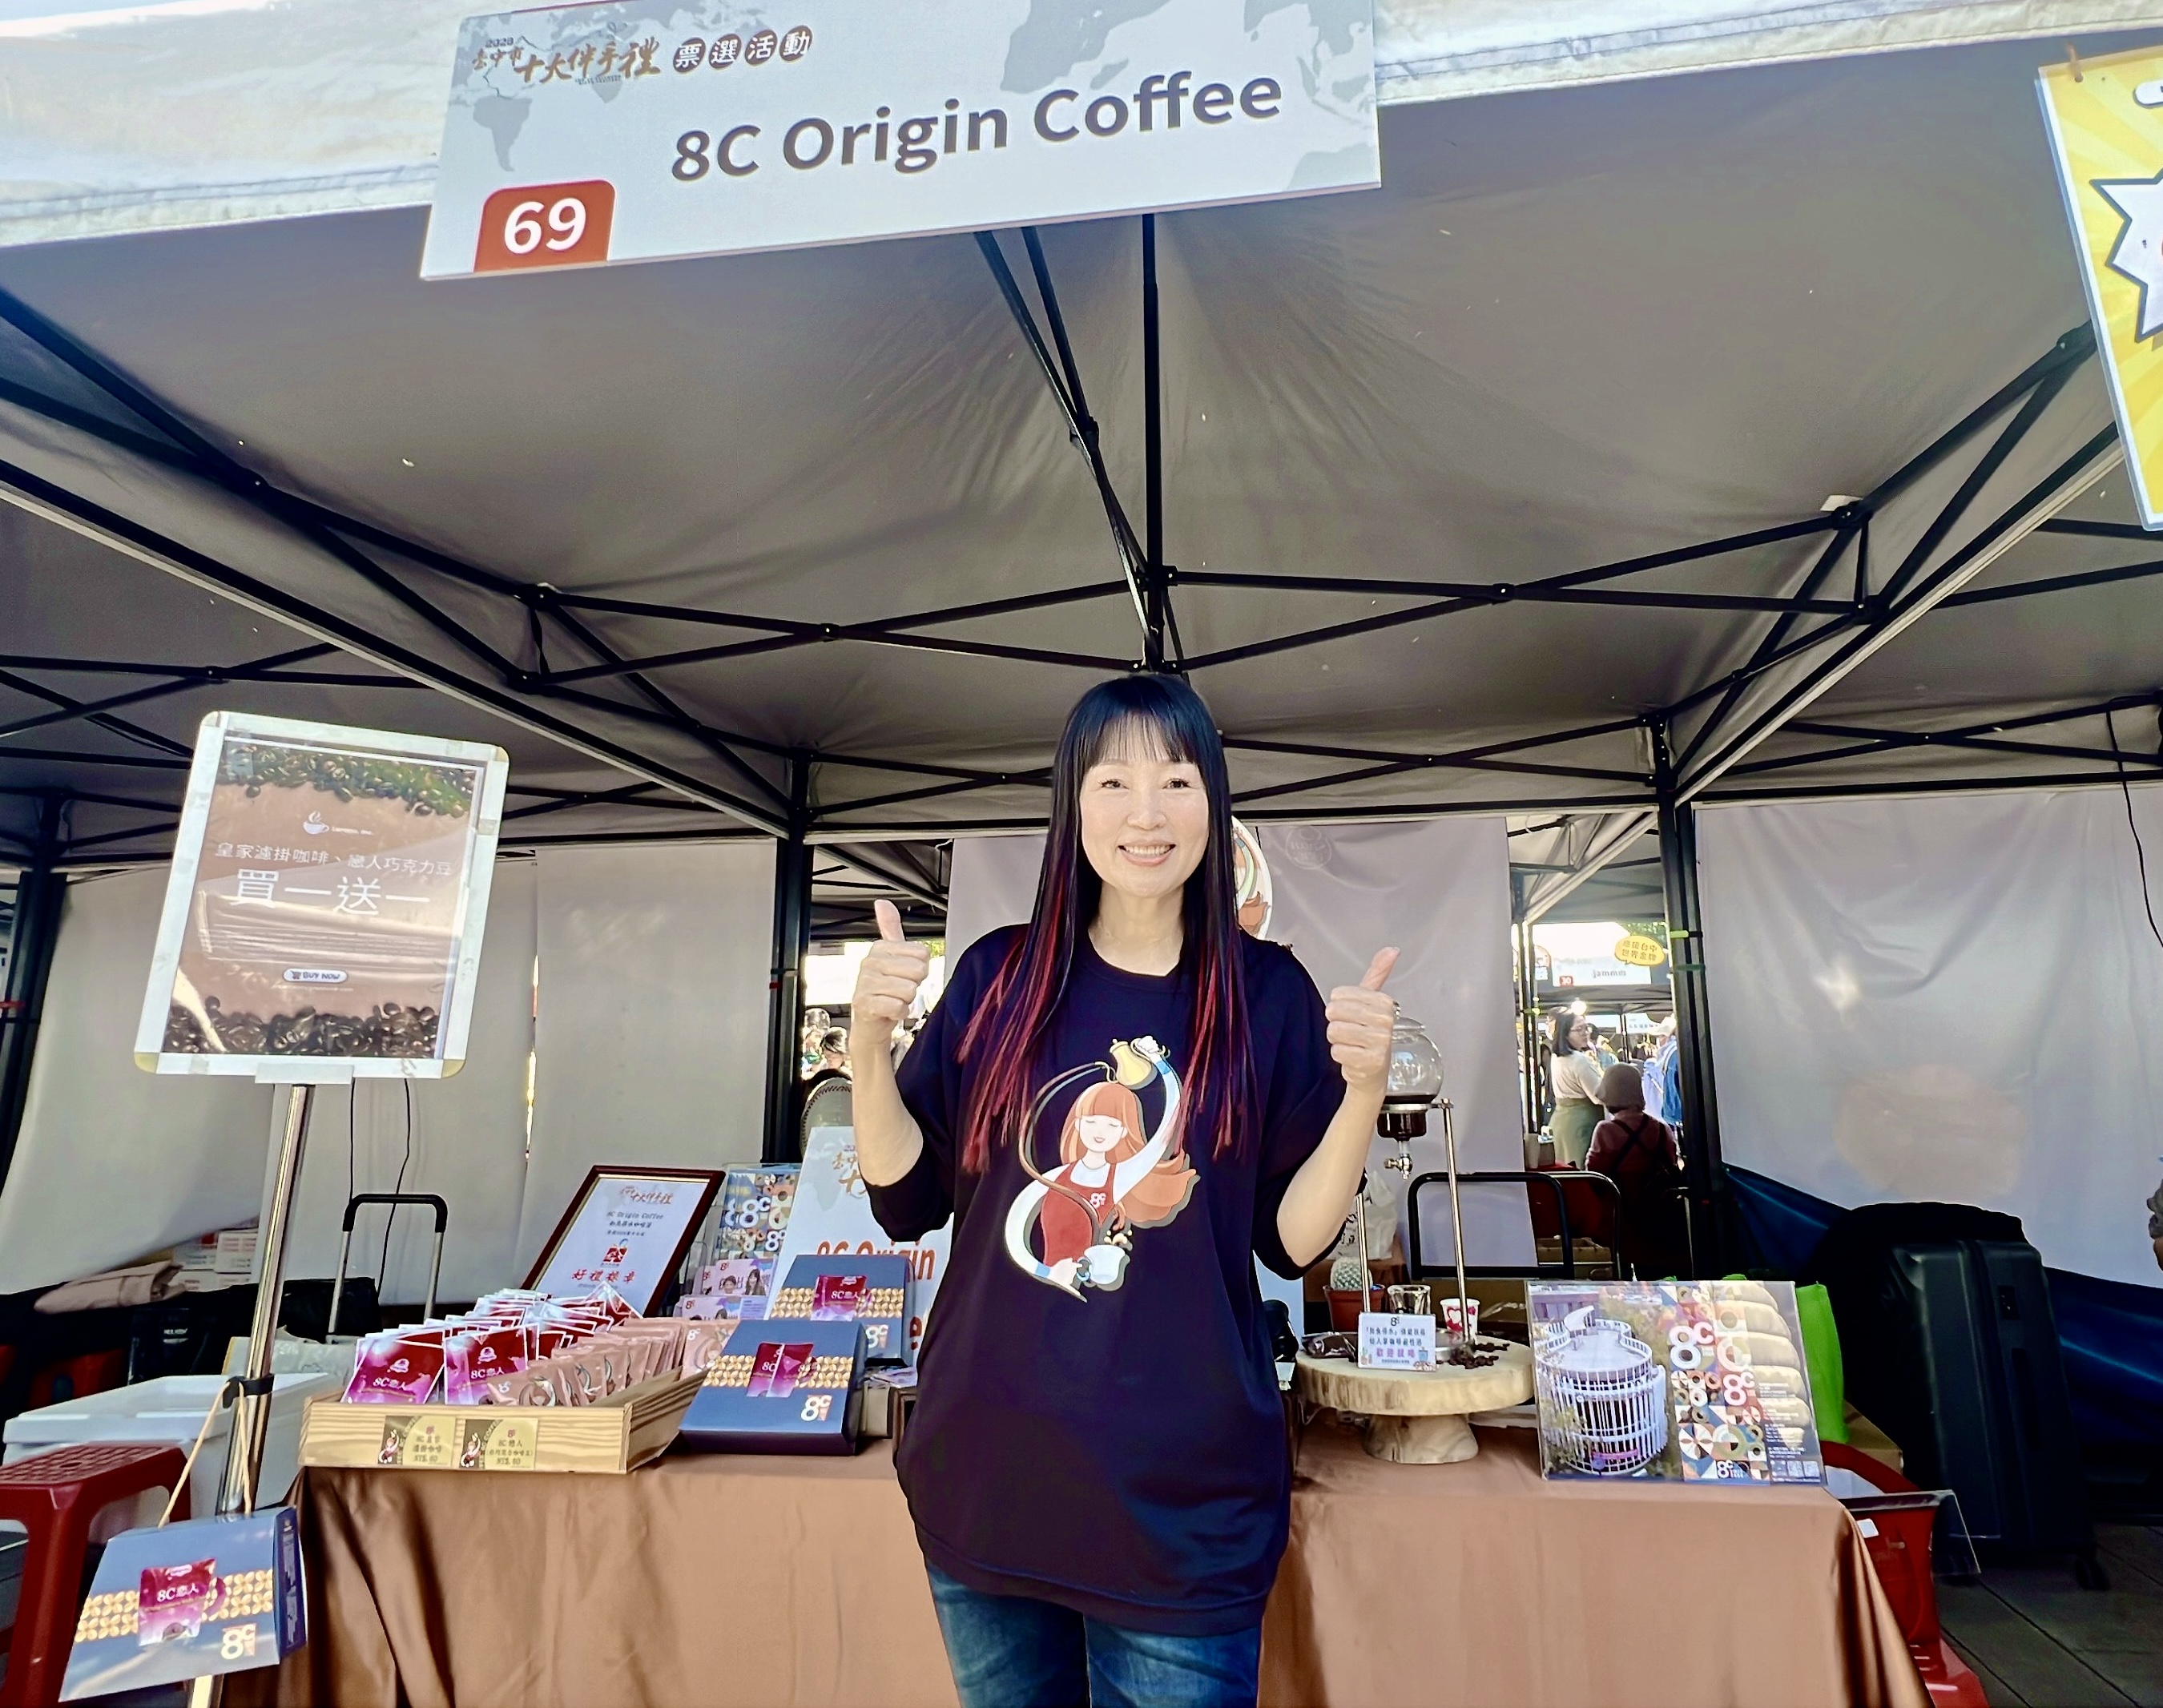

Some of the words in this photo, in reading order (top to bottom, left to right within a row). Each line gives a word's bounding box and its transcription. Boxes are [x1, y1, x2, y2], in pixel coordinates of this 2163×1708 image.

[674, 27, 812, 71] 票選活動
[671, 123, 760, 182] 8C
[781, 98, 1009, 174] Origin
[1033, 72, 1283, 143] Coffee
[502, 197, 586, 256] 69
[230, 868, 430, 916] 買一送一
